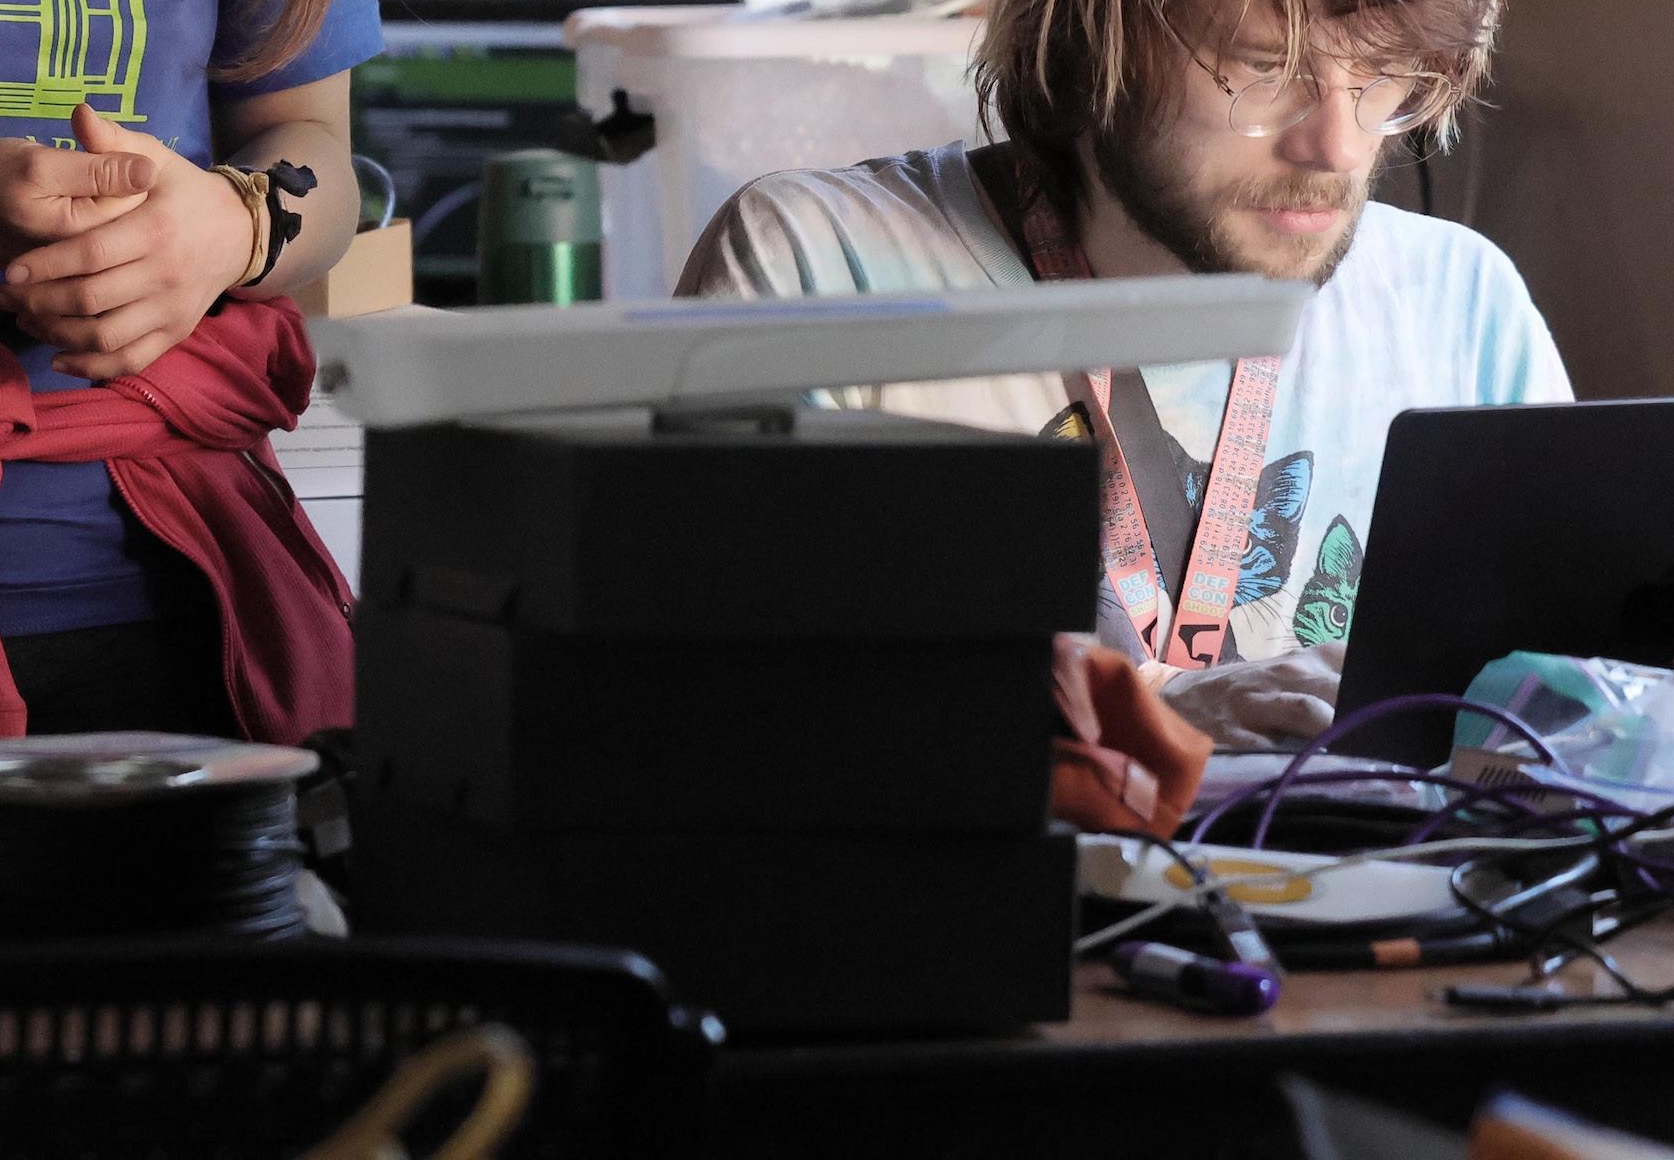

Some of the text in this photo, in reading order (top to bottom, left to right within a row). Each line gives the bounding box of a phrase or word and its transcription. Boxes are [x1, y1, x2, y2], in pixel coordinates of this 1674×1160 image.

[1118, 569, 1149, 592] DEF
[1194, 572, 1229, 588] DEF
[1124, 583, 1156, 605] CON
[1188, 587, 1227, 607] CON
